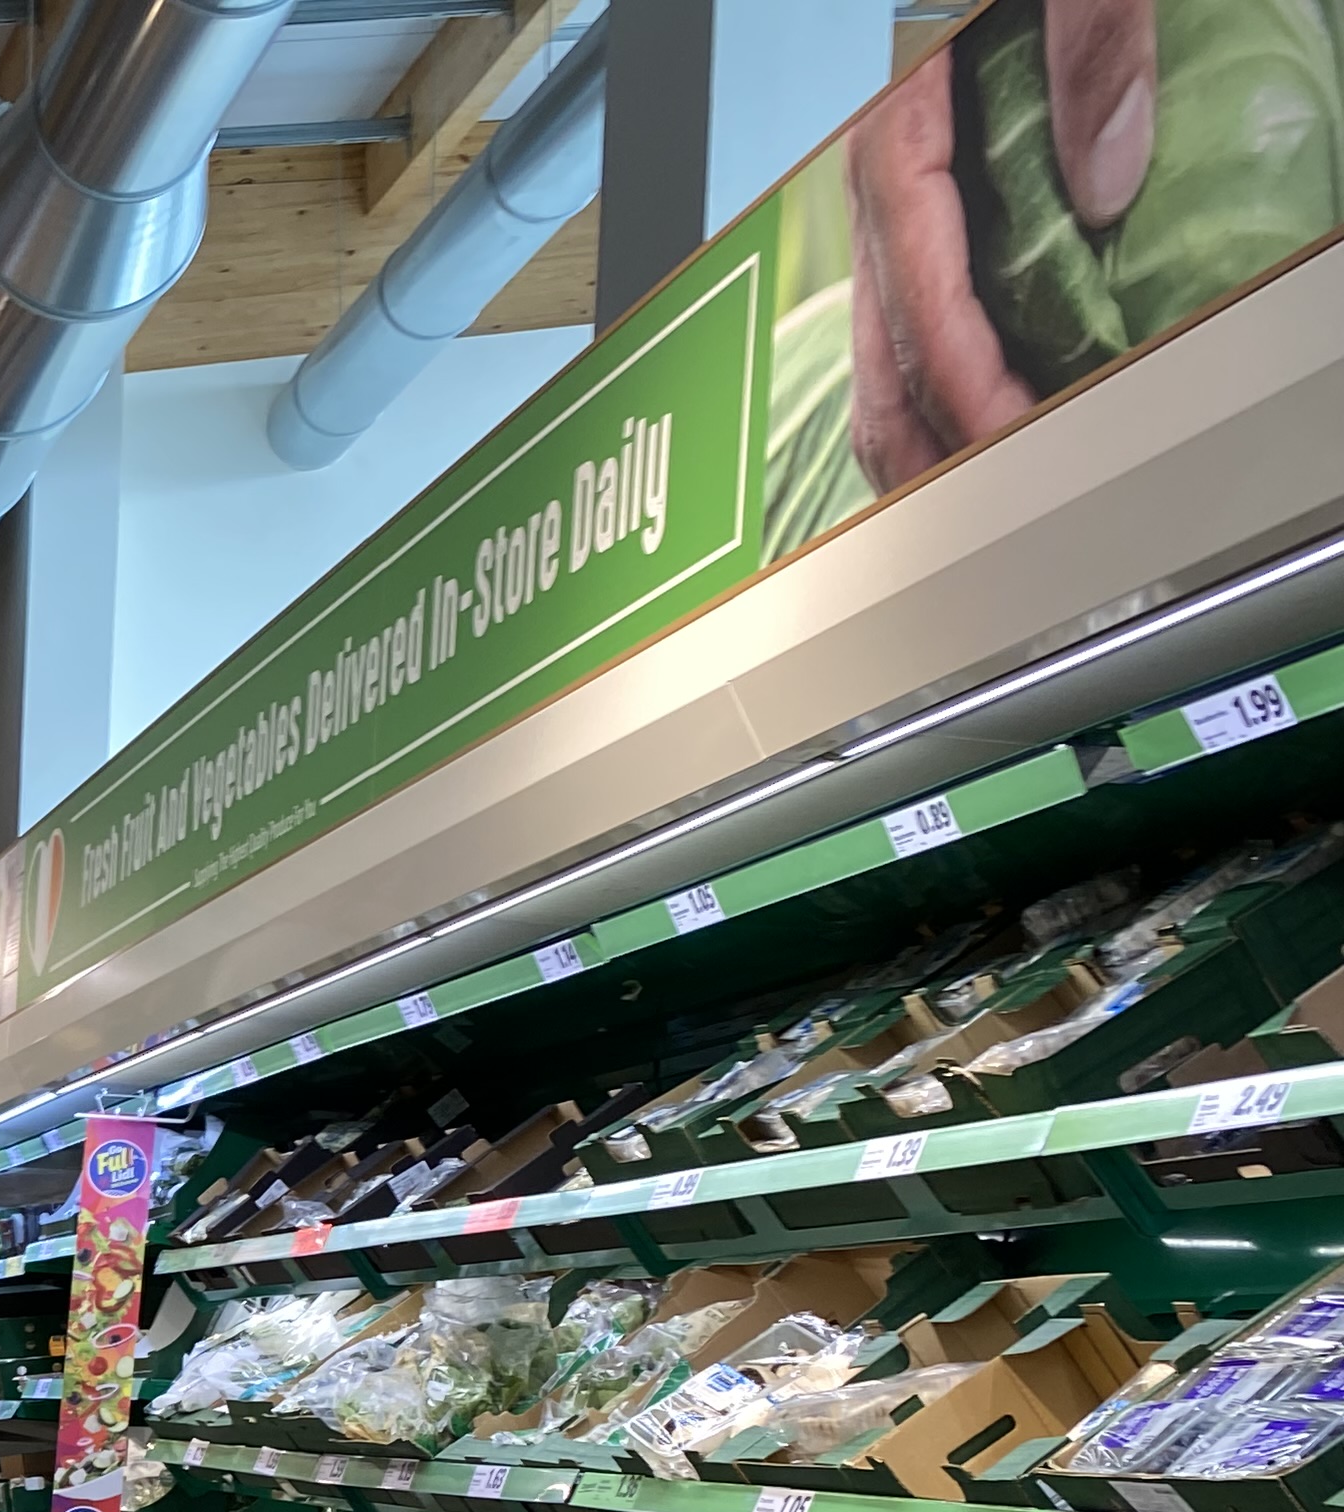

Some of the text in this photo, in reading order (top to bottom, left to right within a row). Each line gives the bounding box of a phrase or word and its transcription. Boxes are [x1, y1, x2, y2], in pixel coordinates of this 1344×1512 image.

[81, 412, 673, 907] Fresh Fruit And Vegetables Delivered In-Store Daily
[1232, 685, 1286, 729] 1.99
[915, 801, 952, 835] 0.89
[1233, 1082, 1289, 1117] 2.49
[111, 1167, 135, 1183] Lidl
